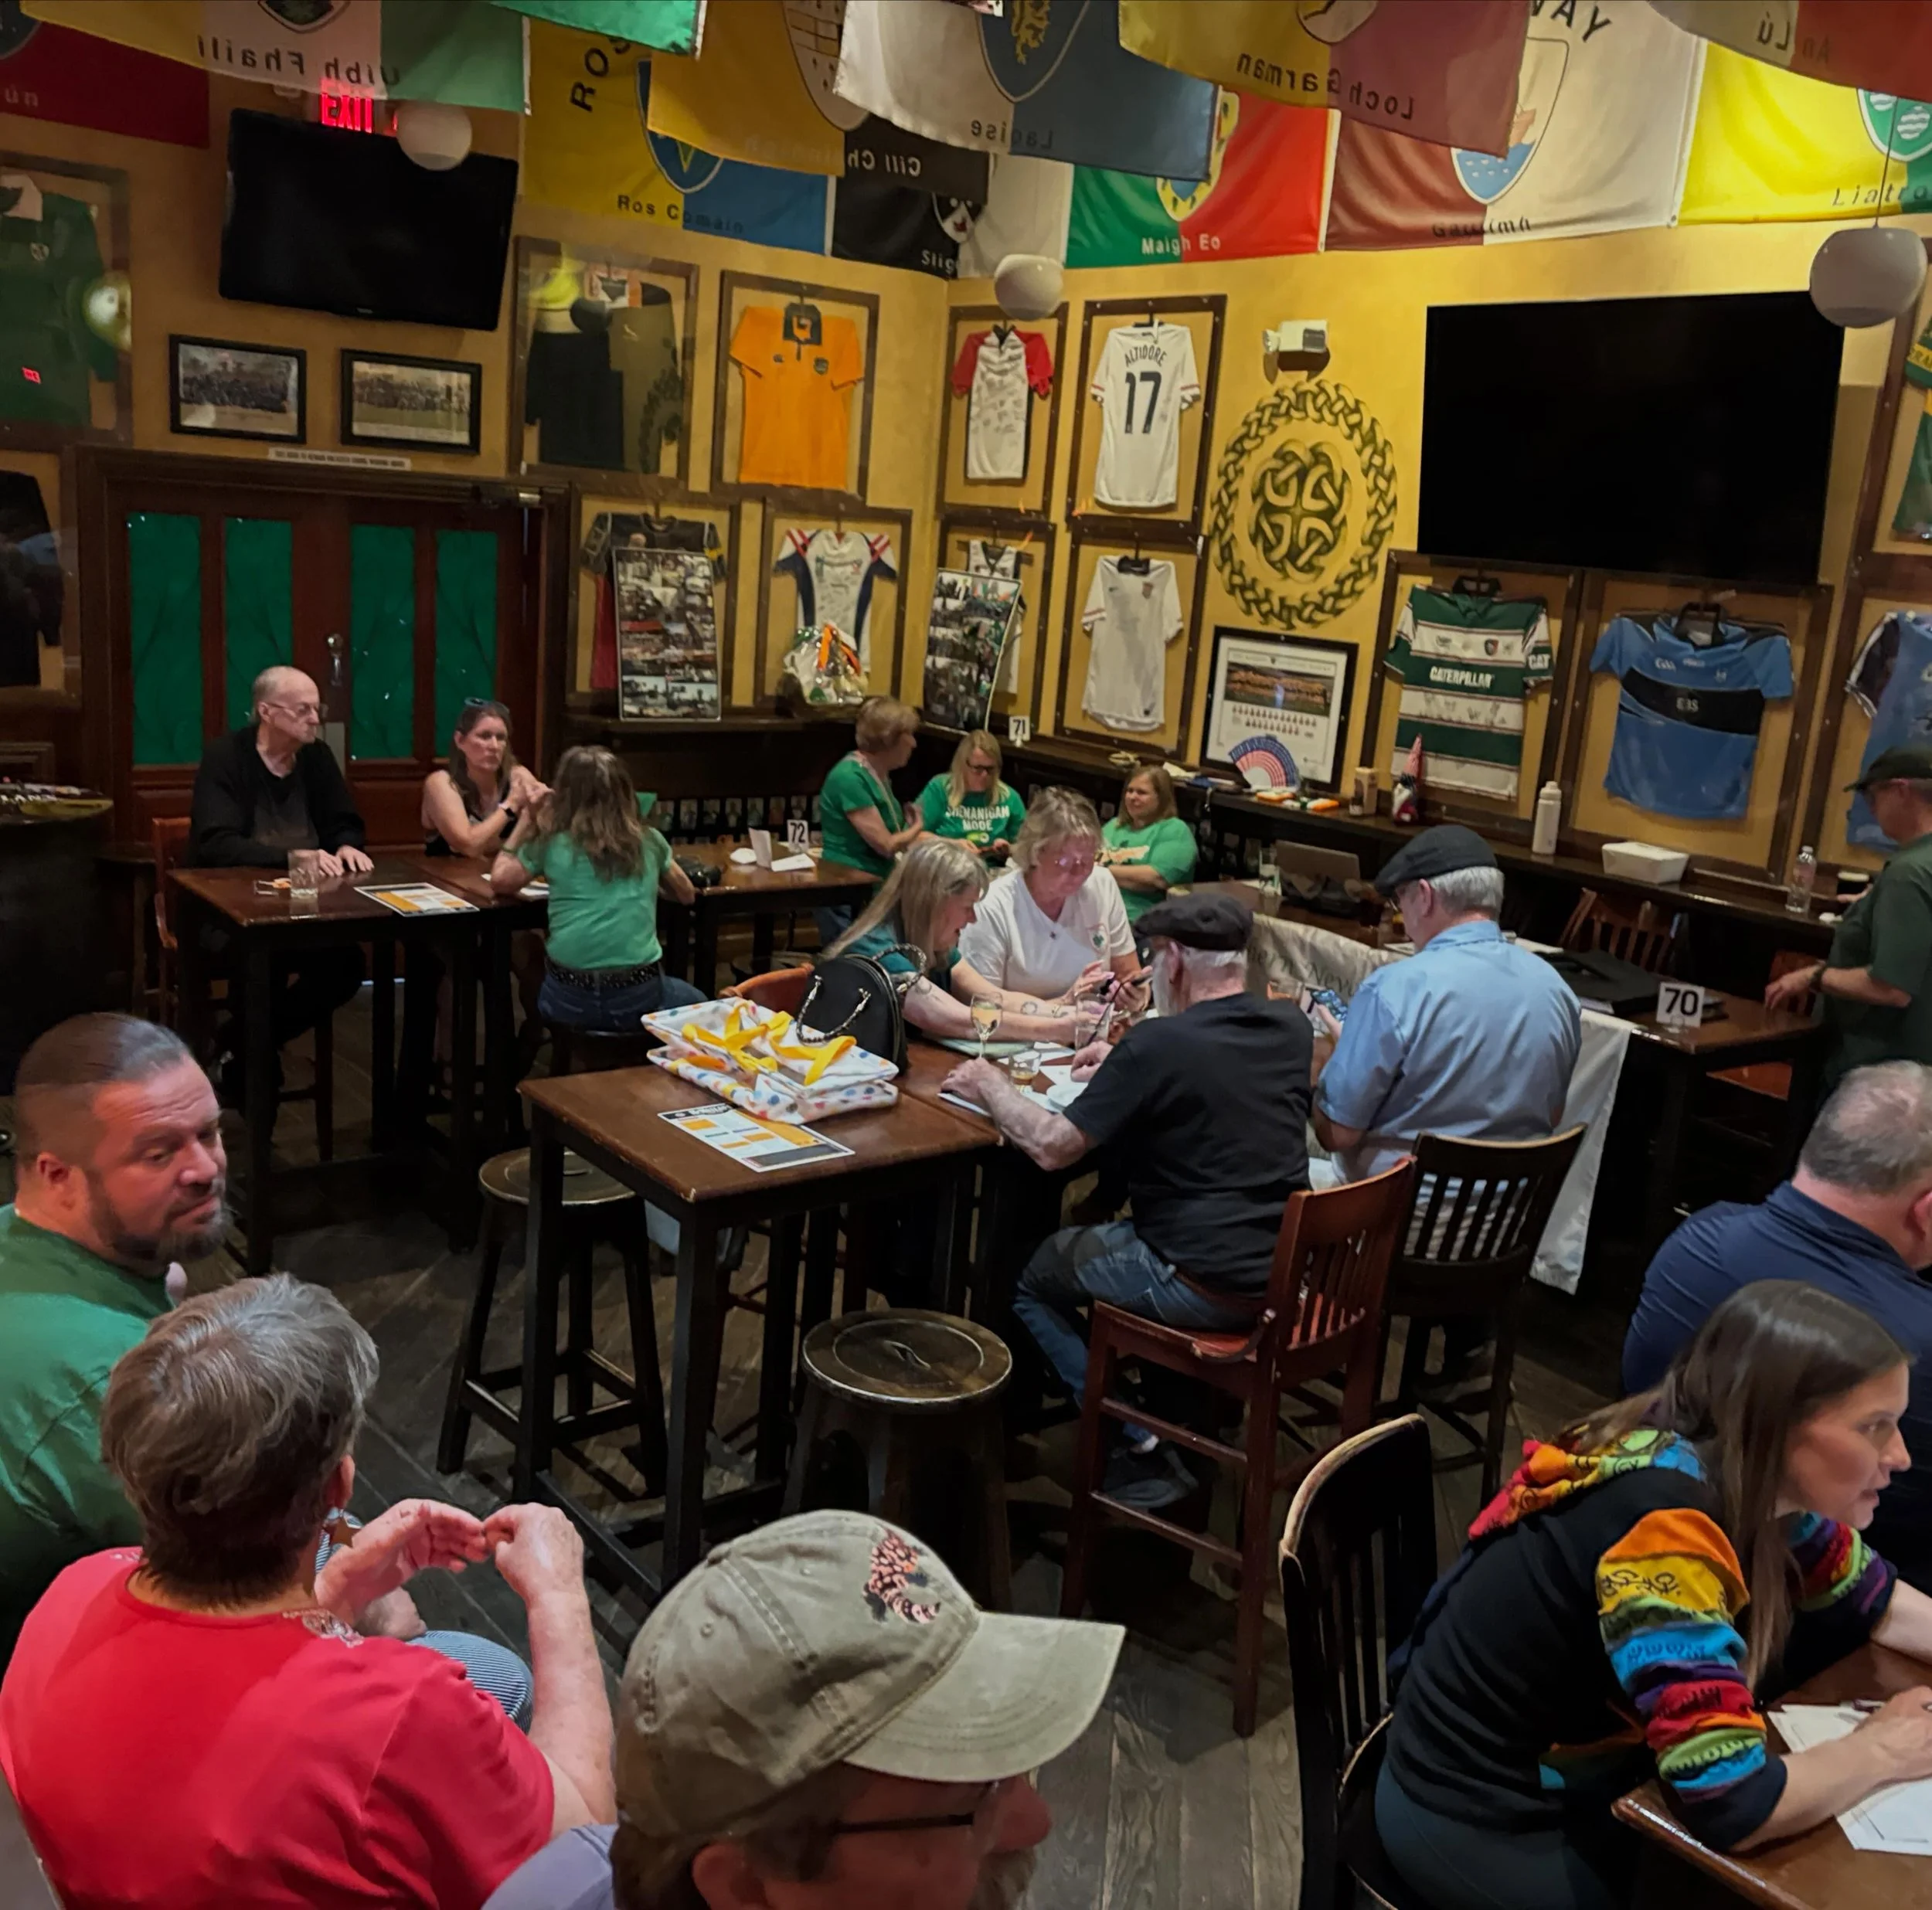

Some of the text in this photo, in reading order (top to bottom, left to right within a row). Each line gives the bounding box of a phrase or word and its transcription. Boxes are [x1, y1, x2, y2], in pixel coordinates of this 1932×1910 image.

[1531, 0, 1614, 43] AY
[617, 193, 656, 218] Ros
[1141, 233, 1221, 257] Maigh Eo
[1124, 344, 1167, 367] ALTIDORE
[1124, 371, 1162, 434] 17
[1528, 653, 1550, 671] CAT
[1430, 665, 1492, 689] CATERPILLAR
[1012, 719, 1026, 735] 71
[790, 822, 805, 843] 72
[963, 819, 994, 832] MODE
[1665, 987, 1699, 1017] 70
